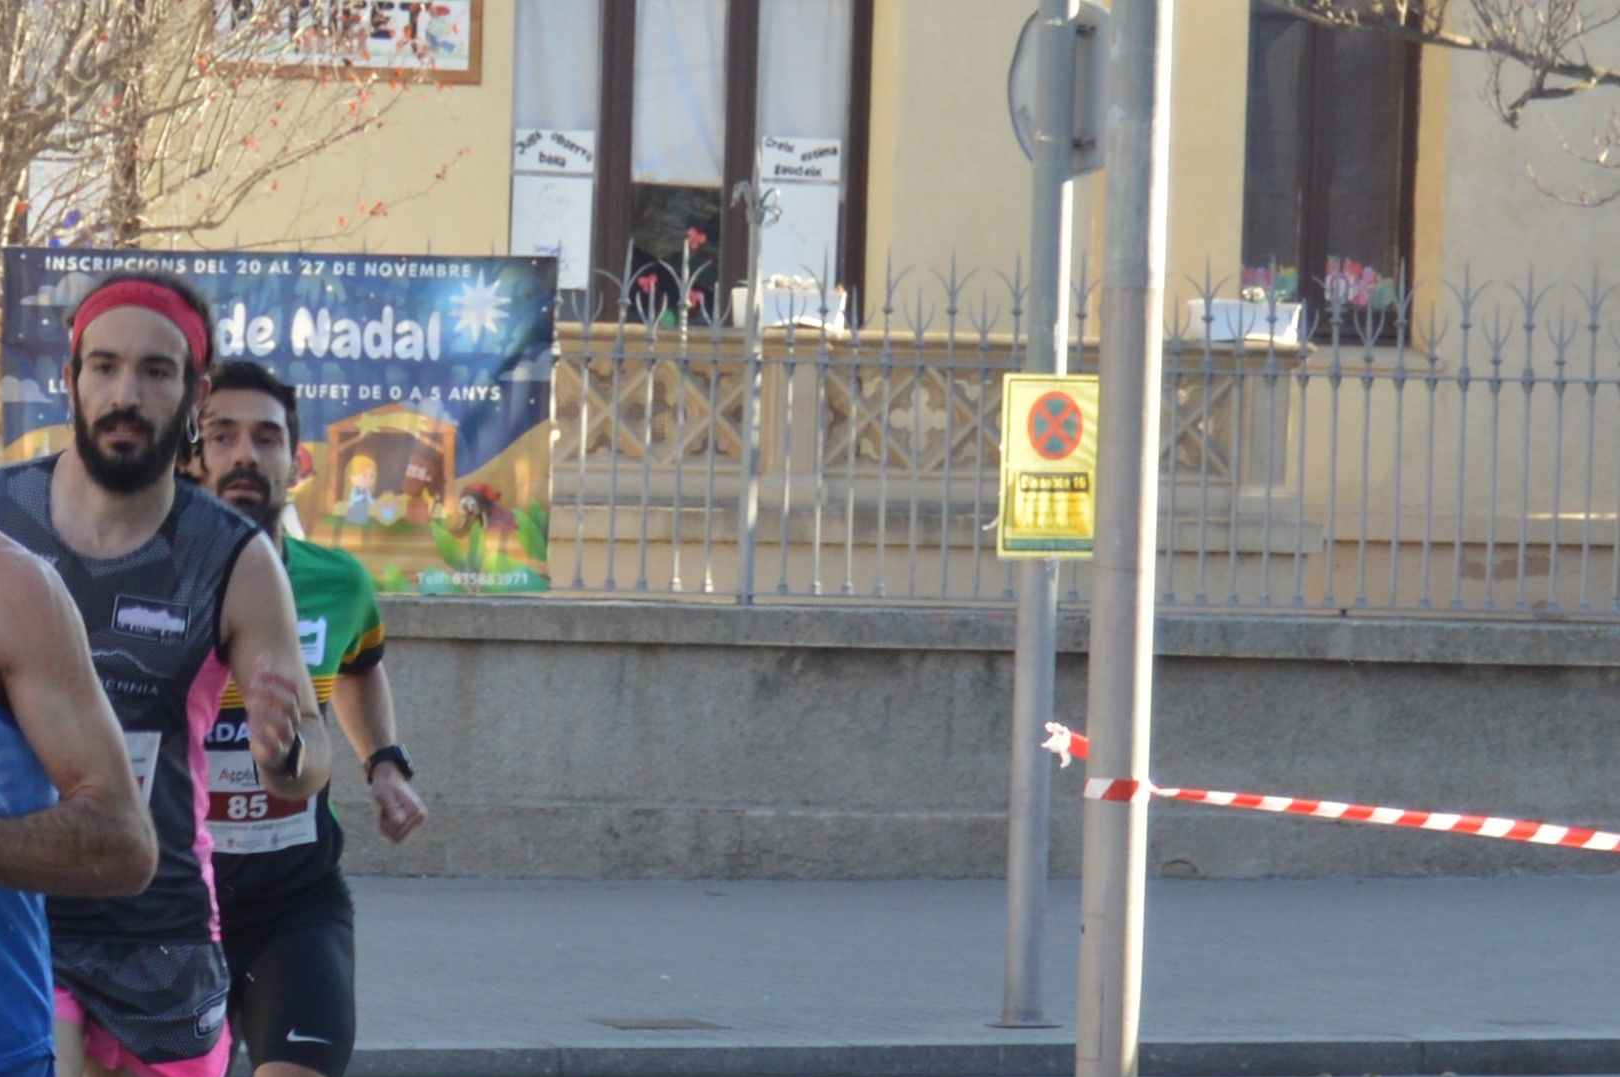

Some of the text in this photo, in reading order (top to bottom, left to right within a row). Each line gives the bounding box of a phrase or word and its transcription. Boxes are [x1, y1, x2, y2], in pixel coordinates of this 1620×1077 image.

[45, 256, 186, 273] INSCRIPCIONS
[193, 259, 227, 273] DEL
[236, 260, 261, 274] 20
[268, 260, 292, 275] AL
[333, 262, 356, 276] DE
[364, 262, 472, 278] NOVEMBRE
[217, 302, 442, 362] de Nadal
[295, 383, 351, 399] TUFET
[358, 385, 381, 400] DE
[409, 386, 423, 400] A
[430, 386, 440, 401] 5
[448, 386, 502, 401] ANYS
[227, 794, 269, 819] 85
